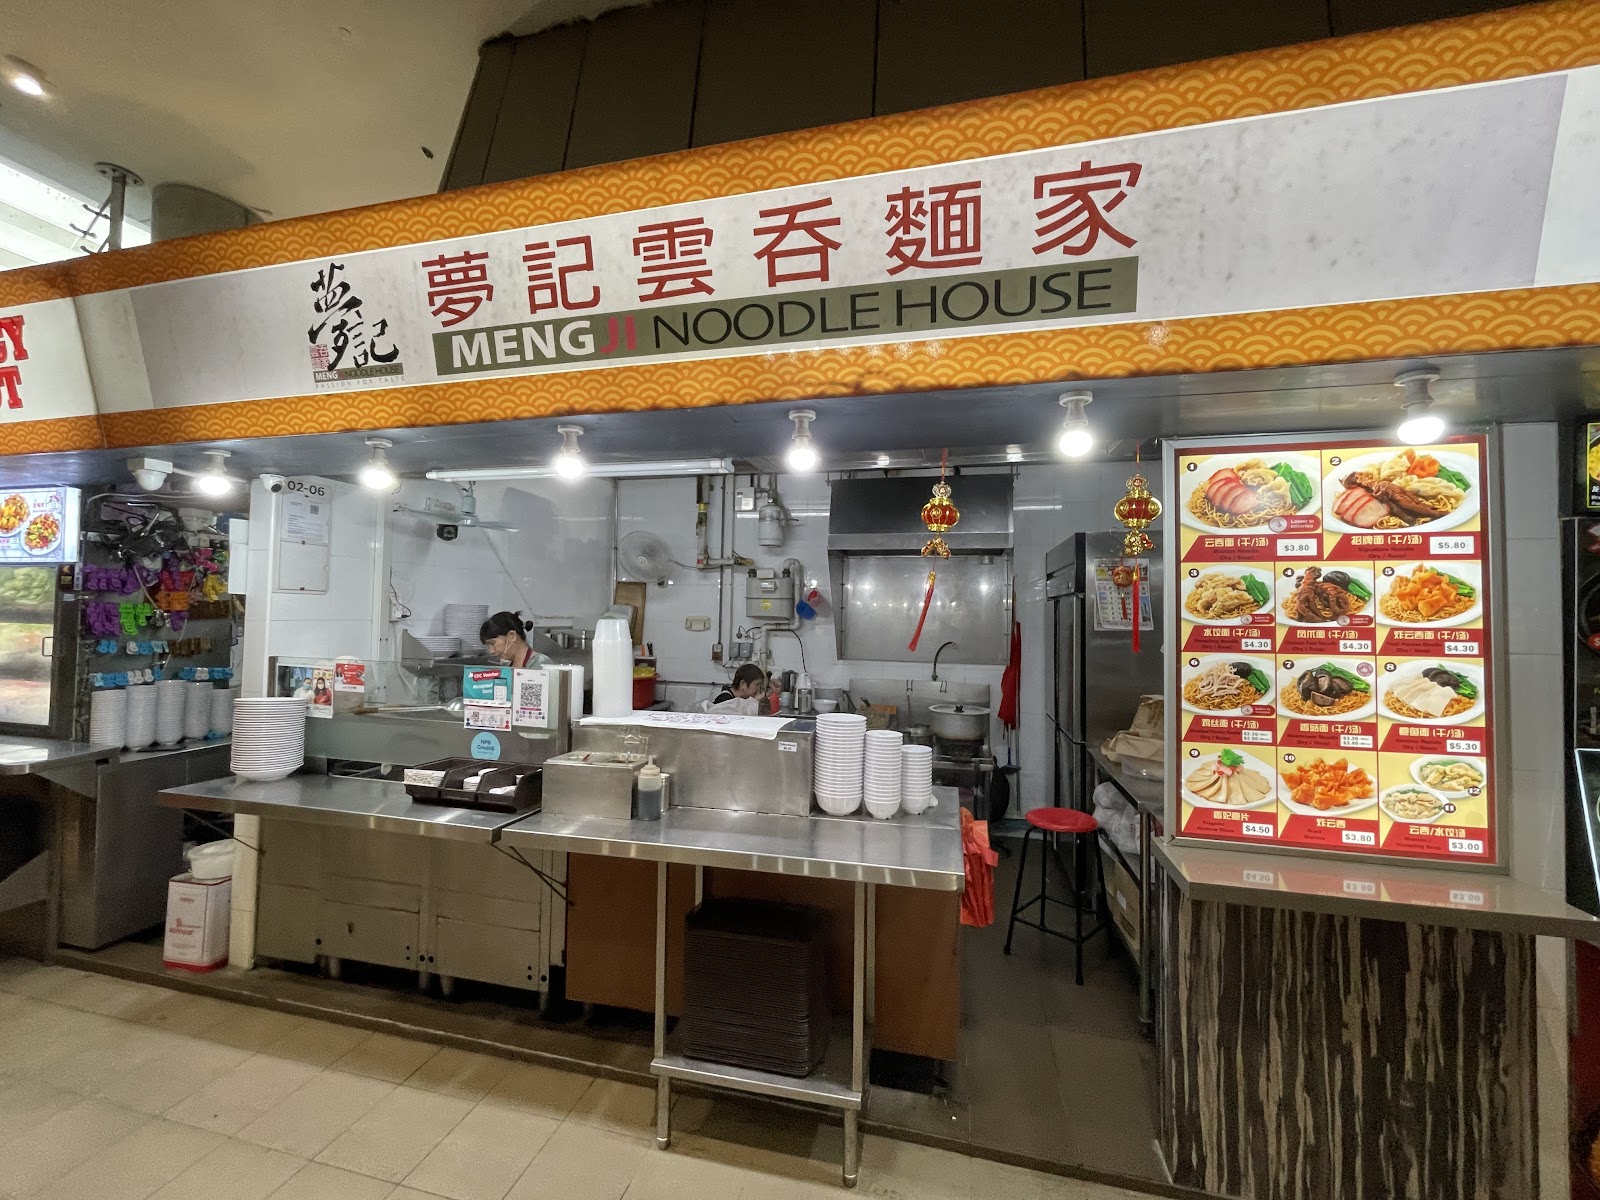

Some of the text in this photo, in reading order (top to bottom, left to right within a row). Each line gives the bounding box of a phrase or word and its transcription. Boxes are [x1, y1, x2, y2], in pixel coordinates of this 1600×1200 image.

[421, 160, 1142, 328] 夢記雲吞麵家
[451, 268, 1112, 368] MENG JI NOODLE HOUSE
[315, 371, 338, 380] MENG
[345, 368, 375, 378] NOODLE
[375, 365, 399, 375] HOUSE
[379, 375, 405, 384] TASTE
[287, 480, 325, 496] 02-06
[1284, 544, 1310, 552] $3.80
[1342, 642, 1369, 650] $4.30
[1449, 742, 1478, 751] $5.30
[1245, 825, 1270, 833] $4.50
[1345, 833, 1372, 842] $3.80
[1451, 842, 1480, 850] $3.00
